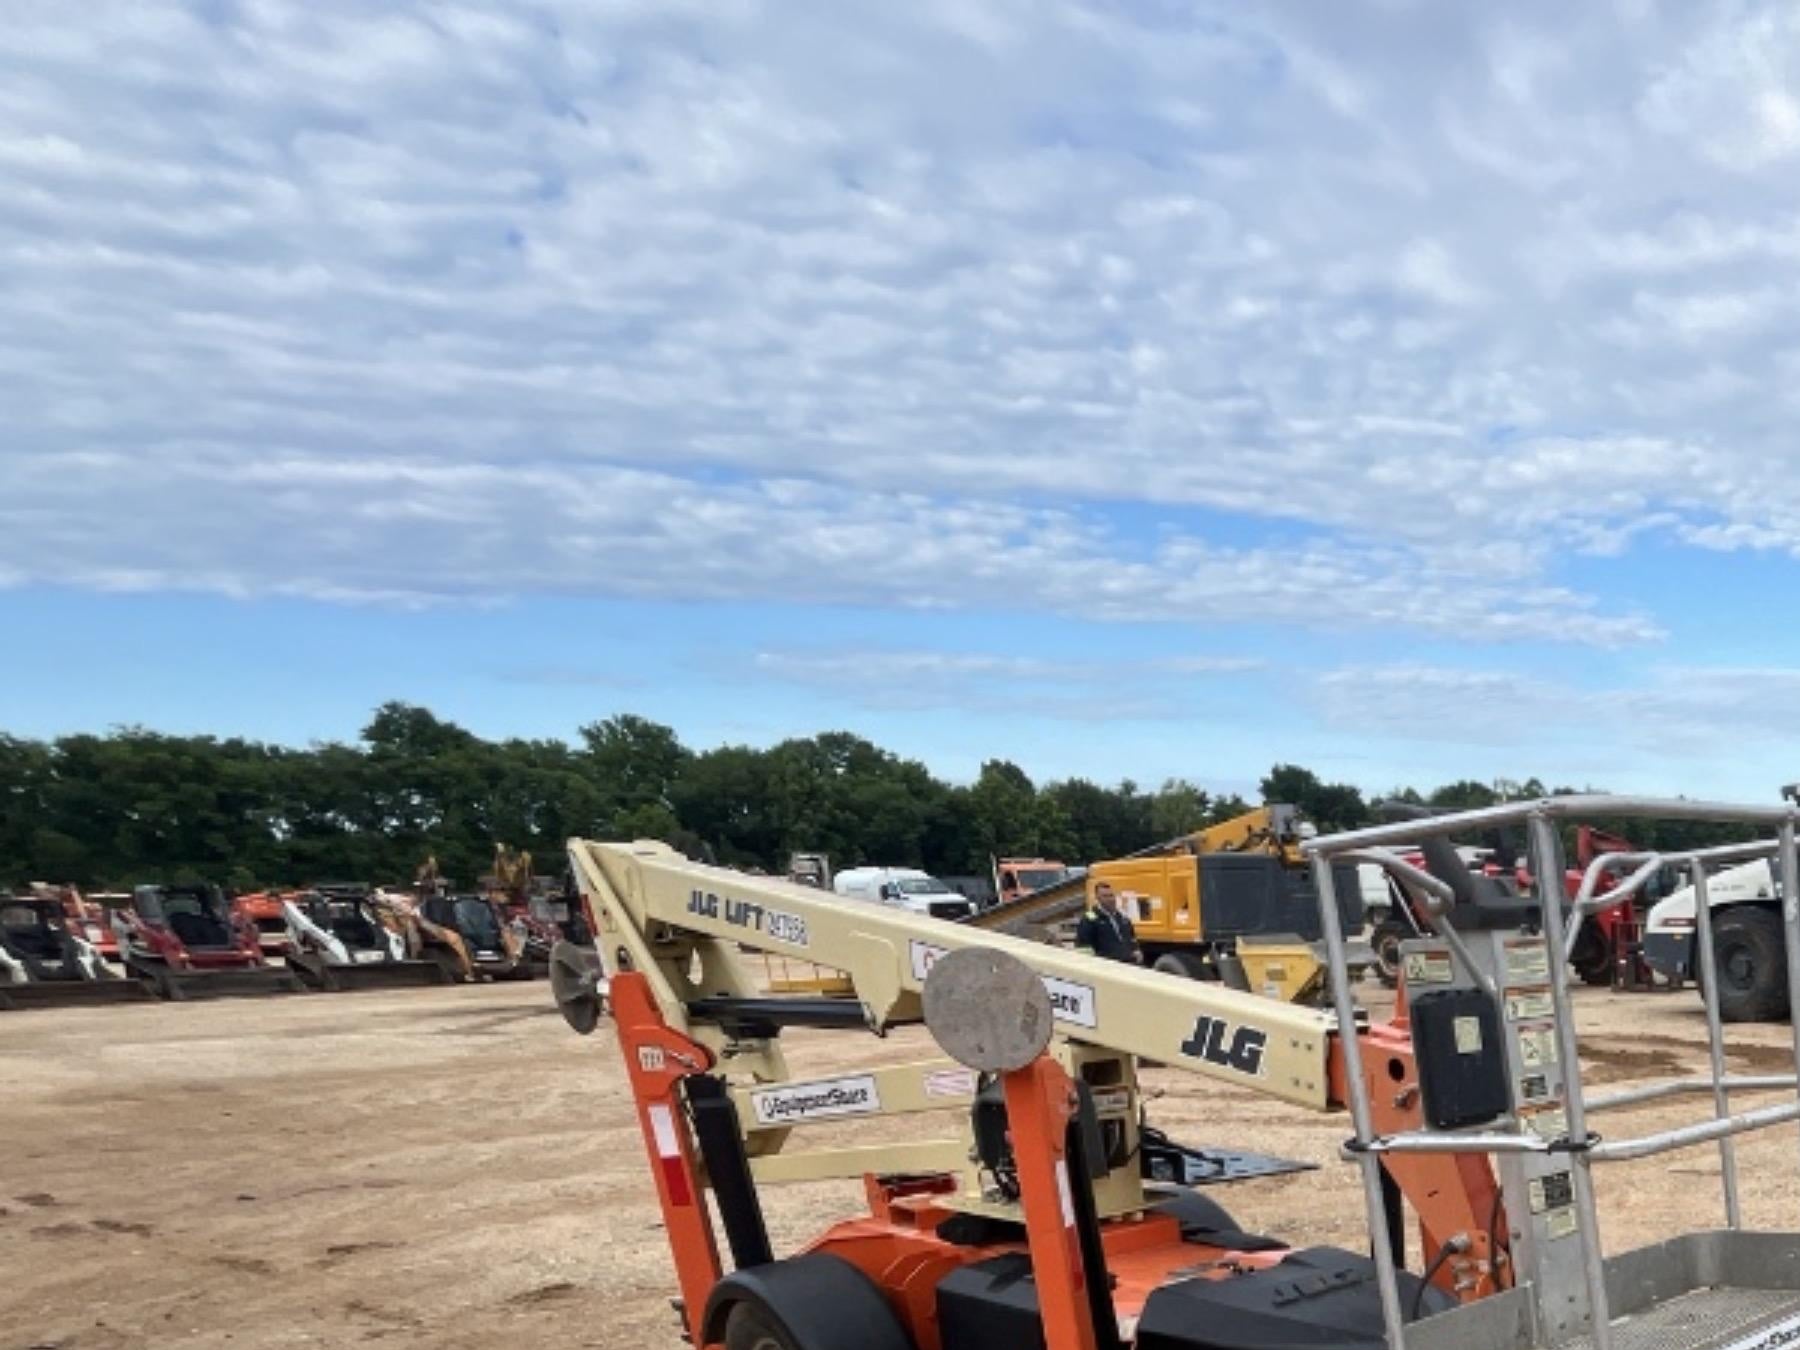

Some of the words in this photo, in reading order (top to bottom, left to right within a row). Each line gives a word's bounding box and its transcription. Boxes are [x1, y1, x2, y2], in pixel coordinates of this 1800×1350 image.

[686, 888, 719, 919] JLG
[725, 896, 765, 930] LIFT
[1180, 1014, 1267, 1076] JLG
